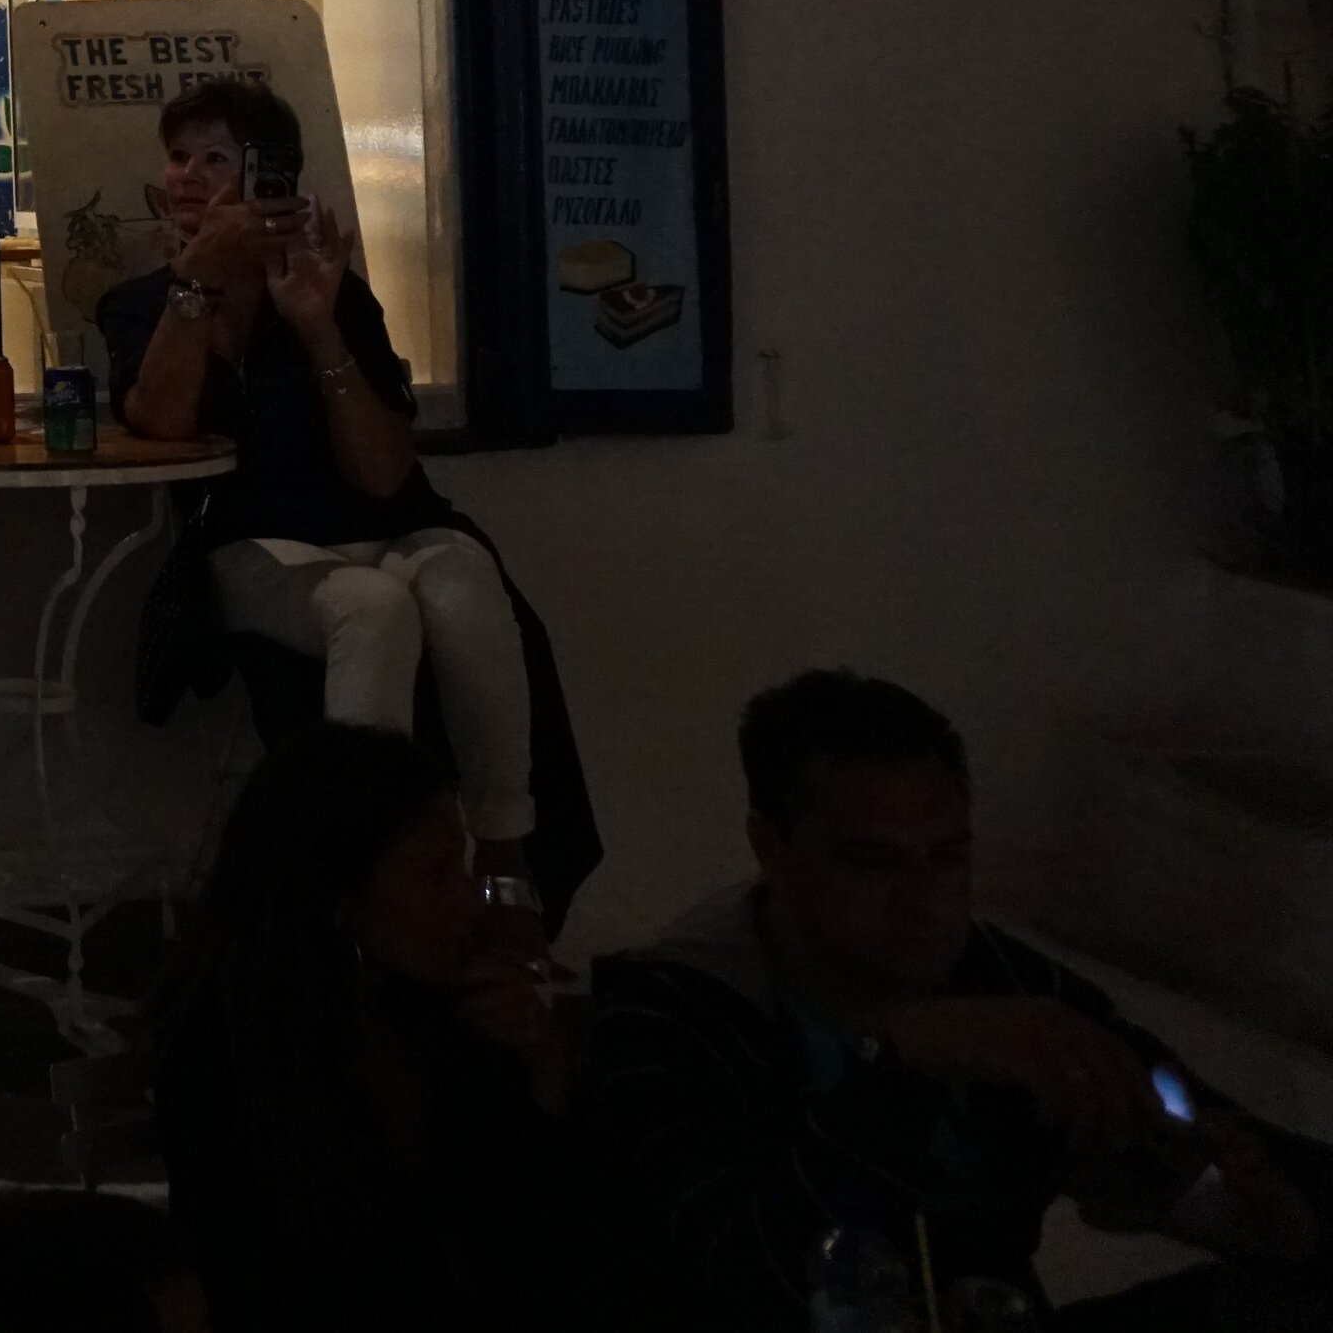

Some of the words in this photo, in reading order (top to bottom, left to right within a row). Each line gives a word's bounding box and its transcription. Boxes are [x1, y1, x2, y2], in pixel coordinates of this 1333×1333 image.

[61, 37, 129, 66] THE
[149, 36, 234, 64] BEST
[549, 34, 585, 64] RICE
[592, 34, 667, 66] PUDDING
[65, 73, 164, 102] FRESH
[550, 74, 663, 107] ΜΠΑΚΛΑΒΑΣ
[547, 156, 618, 186] ΠΑΣΤΕΣ
